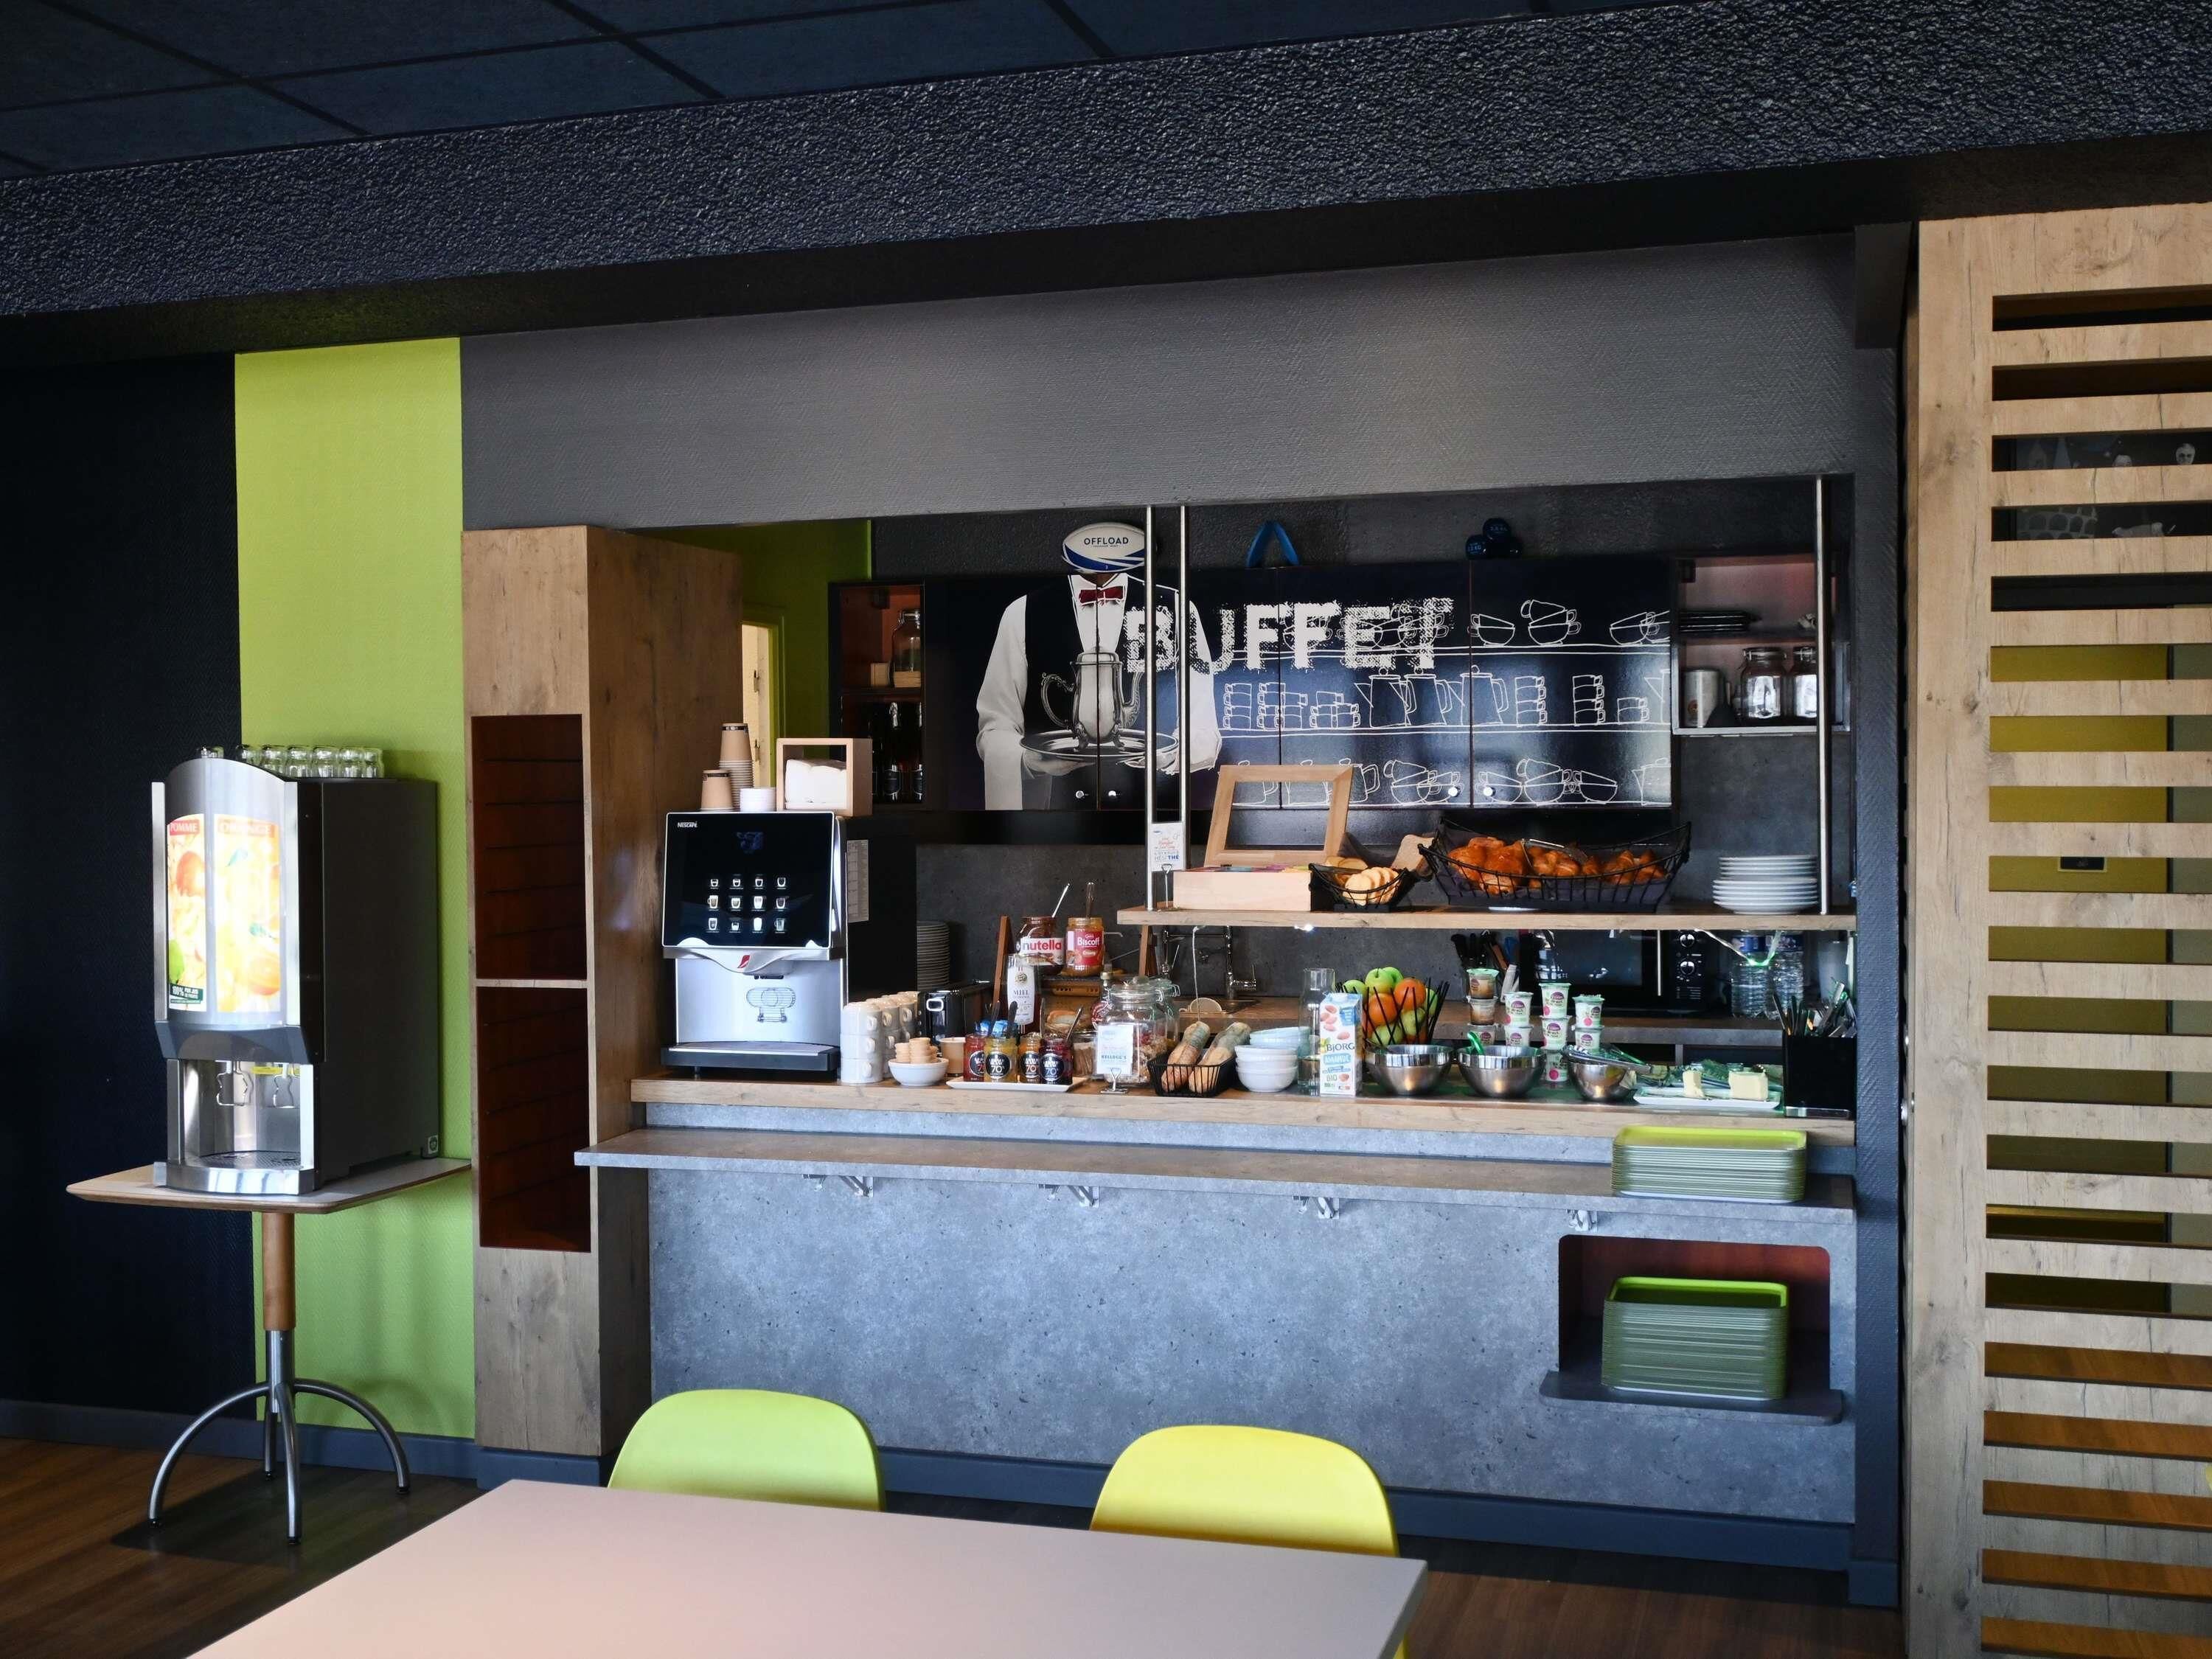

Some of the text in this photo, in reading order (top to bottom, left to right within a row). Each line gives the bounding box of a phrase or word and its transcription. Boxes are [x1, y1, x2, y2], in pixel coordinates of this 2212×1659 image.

[1124, 597, 1454, 673] BUFFET
[170, 822, 198, 832] POMME
[1023, 939, 1062, 950] nutella
[1077, 936, 1100, 946] Biscoff
[1326, 1043, 1355, 1052] BJORG
